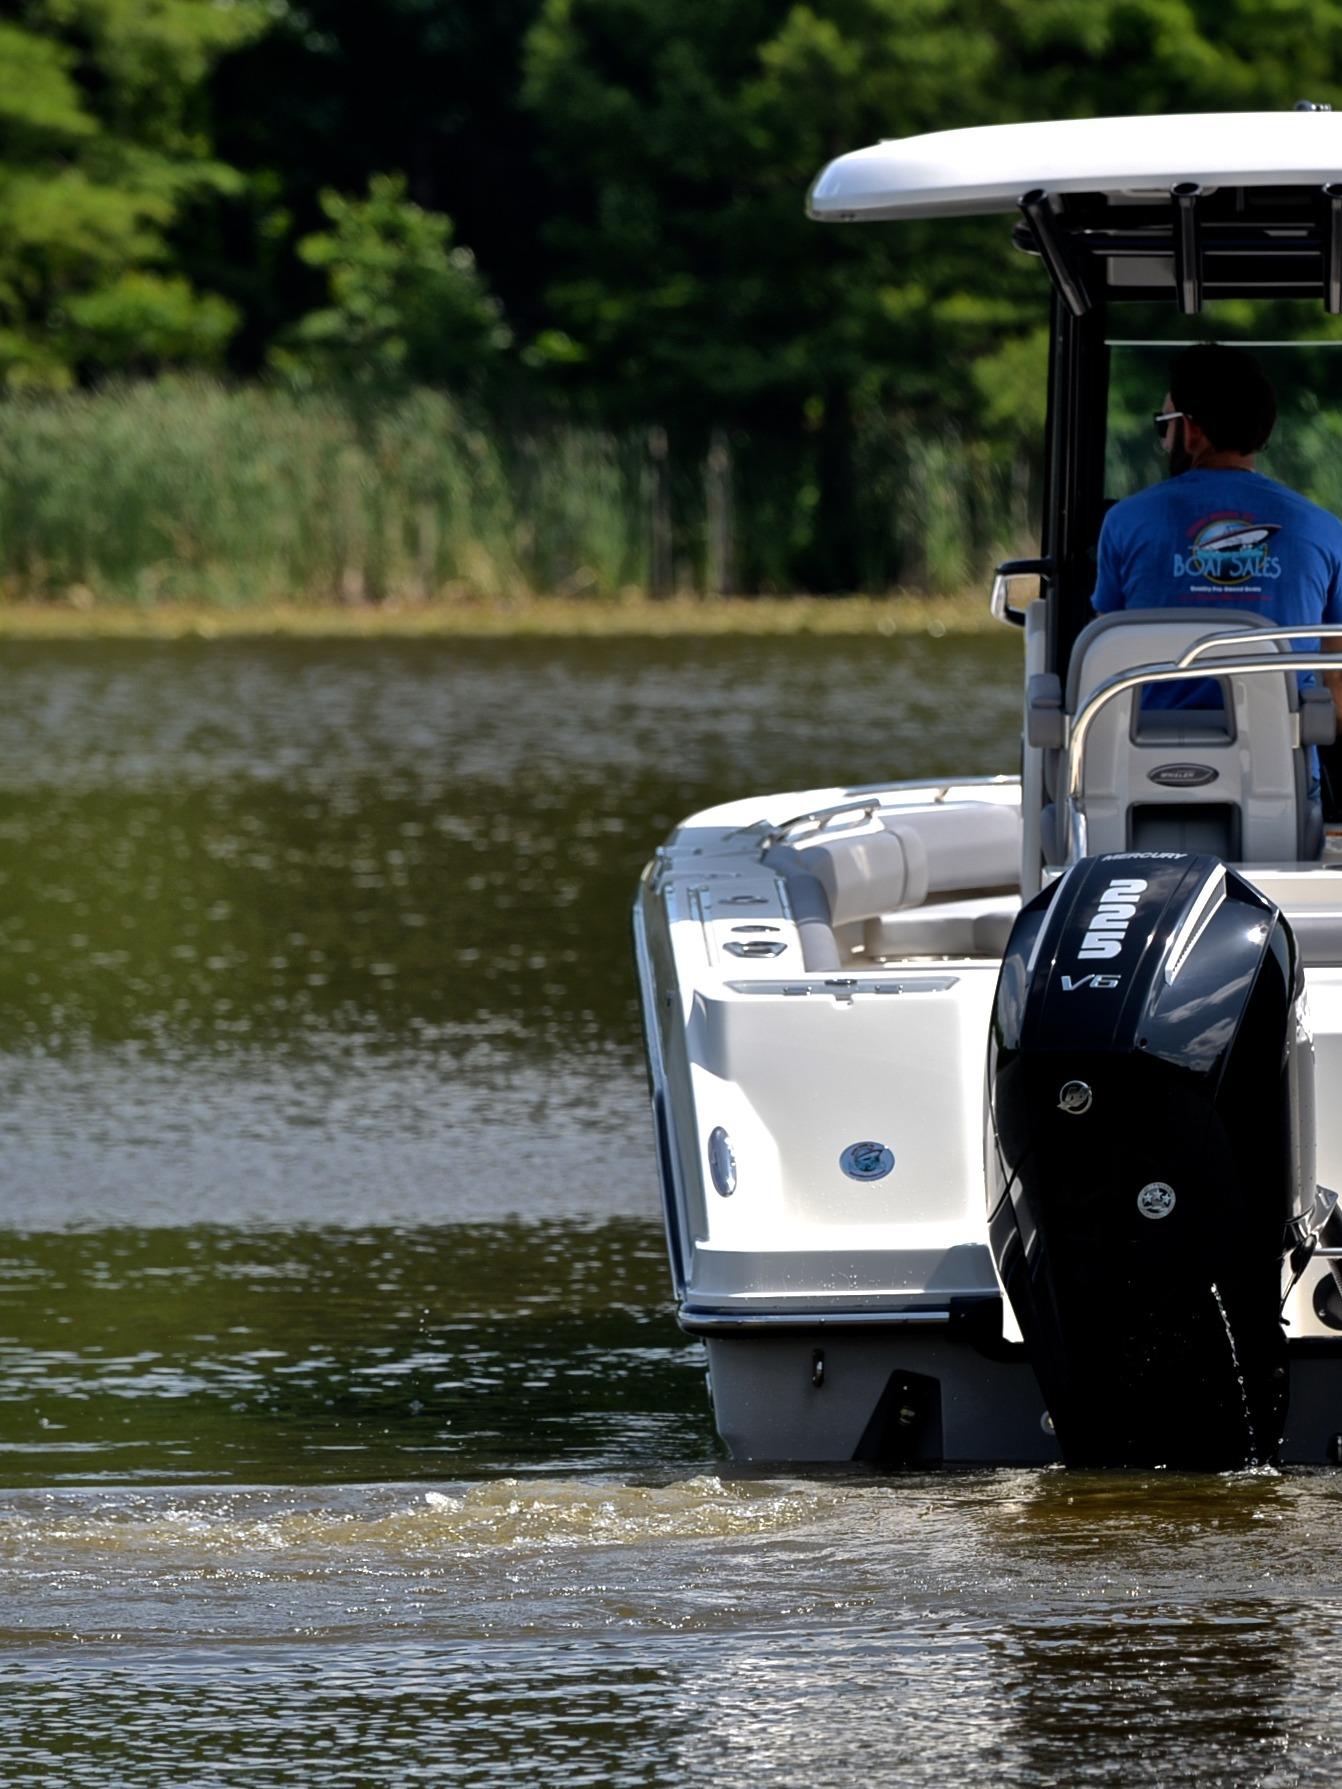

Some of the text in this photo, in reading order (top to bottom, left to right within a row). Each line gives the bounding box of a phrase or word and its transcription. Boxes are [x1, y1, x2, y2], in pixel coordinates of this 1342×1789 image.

[1173, 553, 1282, 579] BOAT SALES
[1101, 851, 1188, 862] MERCURY
[1077, 879, 1148, 959] 225
[1061, 974, 1122, 992] V6
